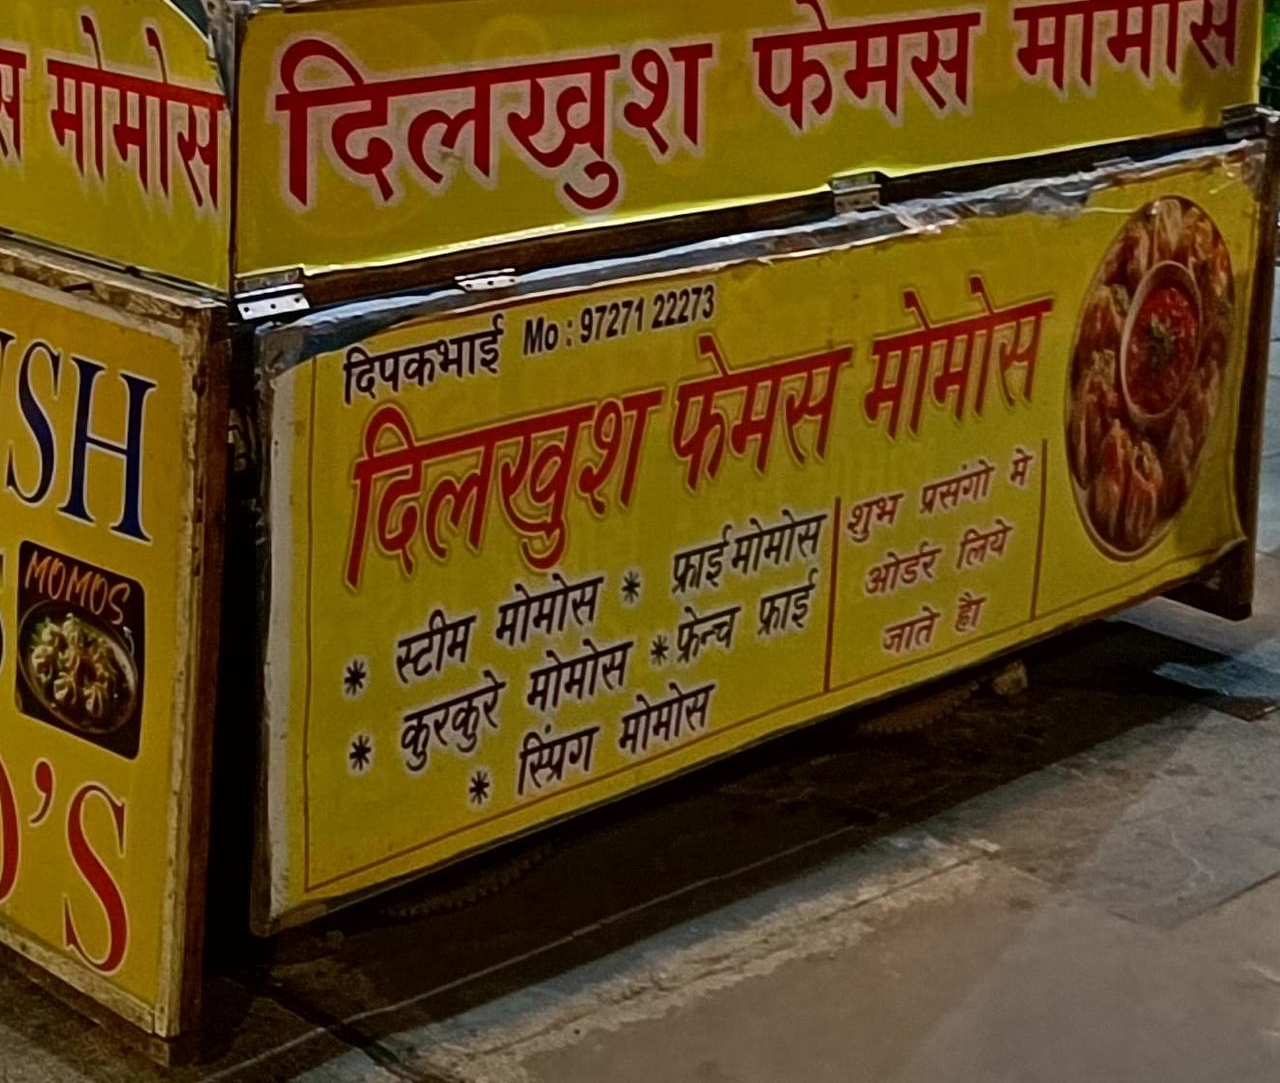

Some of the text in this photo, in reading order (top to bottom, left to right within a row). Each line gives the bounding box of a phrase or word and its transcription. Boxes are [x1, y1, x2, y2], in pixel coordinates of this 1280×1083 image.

[46, 14, 227, 210] मोमोस
[275, 38, 714, 211] दिलखुश
[342, 312, 505, 405] दिपकभाई
[522, 316, 559, 357] Mo
[580, 298, 646, 344] 97271
[650, 284, 716, 330] 22273
[345, 274, 1056, 590] दिलखुश फेमस मोमोस
[671, 508, 828, 595] फ्राई मोमोस
[847, 491, 905, 544] शुभ
[954, 517, 1015, 571] लिये
[24, 549, 131, 627] MOMOS
[395, 573, 604, 684] स्टीम मोमोस
[676, 567, 819, 665] फ्रेन्च फ्राई
[882, 603, 942, 654] जाते
[400, 637, 634, 772] कुरकुरे मोमोस
[517, 681, 716, 796] स्प्रिंग मोमोस
